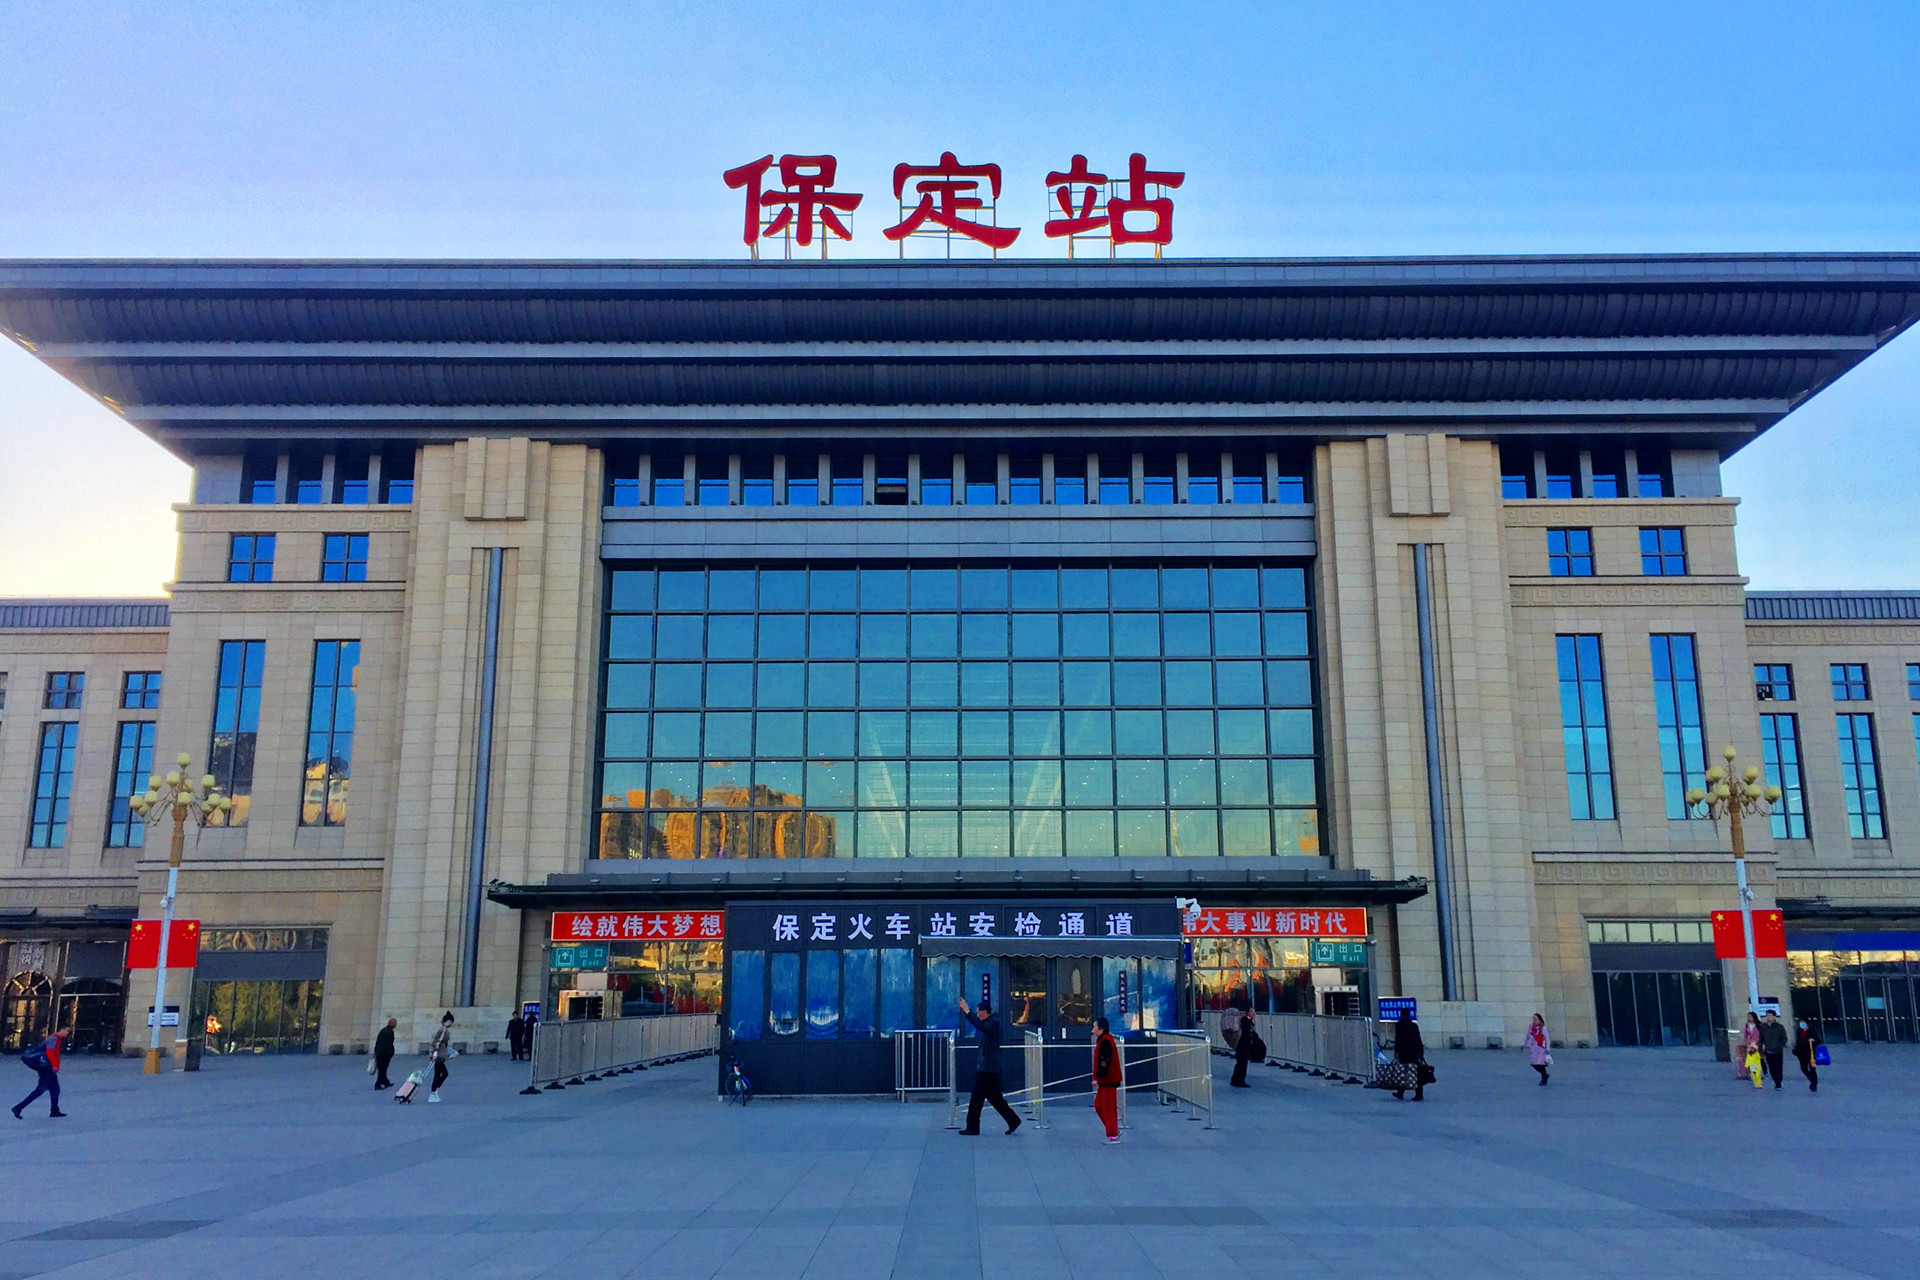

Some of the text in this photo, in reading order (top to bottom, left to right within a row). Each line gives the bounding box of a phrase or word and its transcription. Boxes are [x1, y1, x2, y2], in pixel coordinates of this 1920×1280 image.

[723, 151, 1185, 249] 保定站
[571, 914, 722, 938] 绘就伟大梦想
[773, 912, 1134, 941] 保定火车站安检通道
[579, 948, 604, 958] 出口
[1339, 944, 1363, 953] 出口
[1342, 954, 1360, 962] Exit
